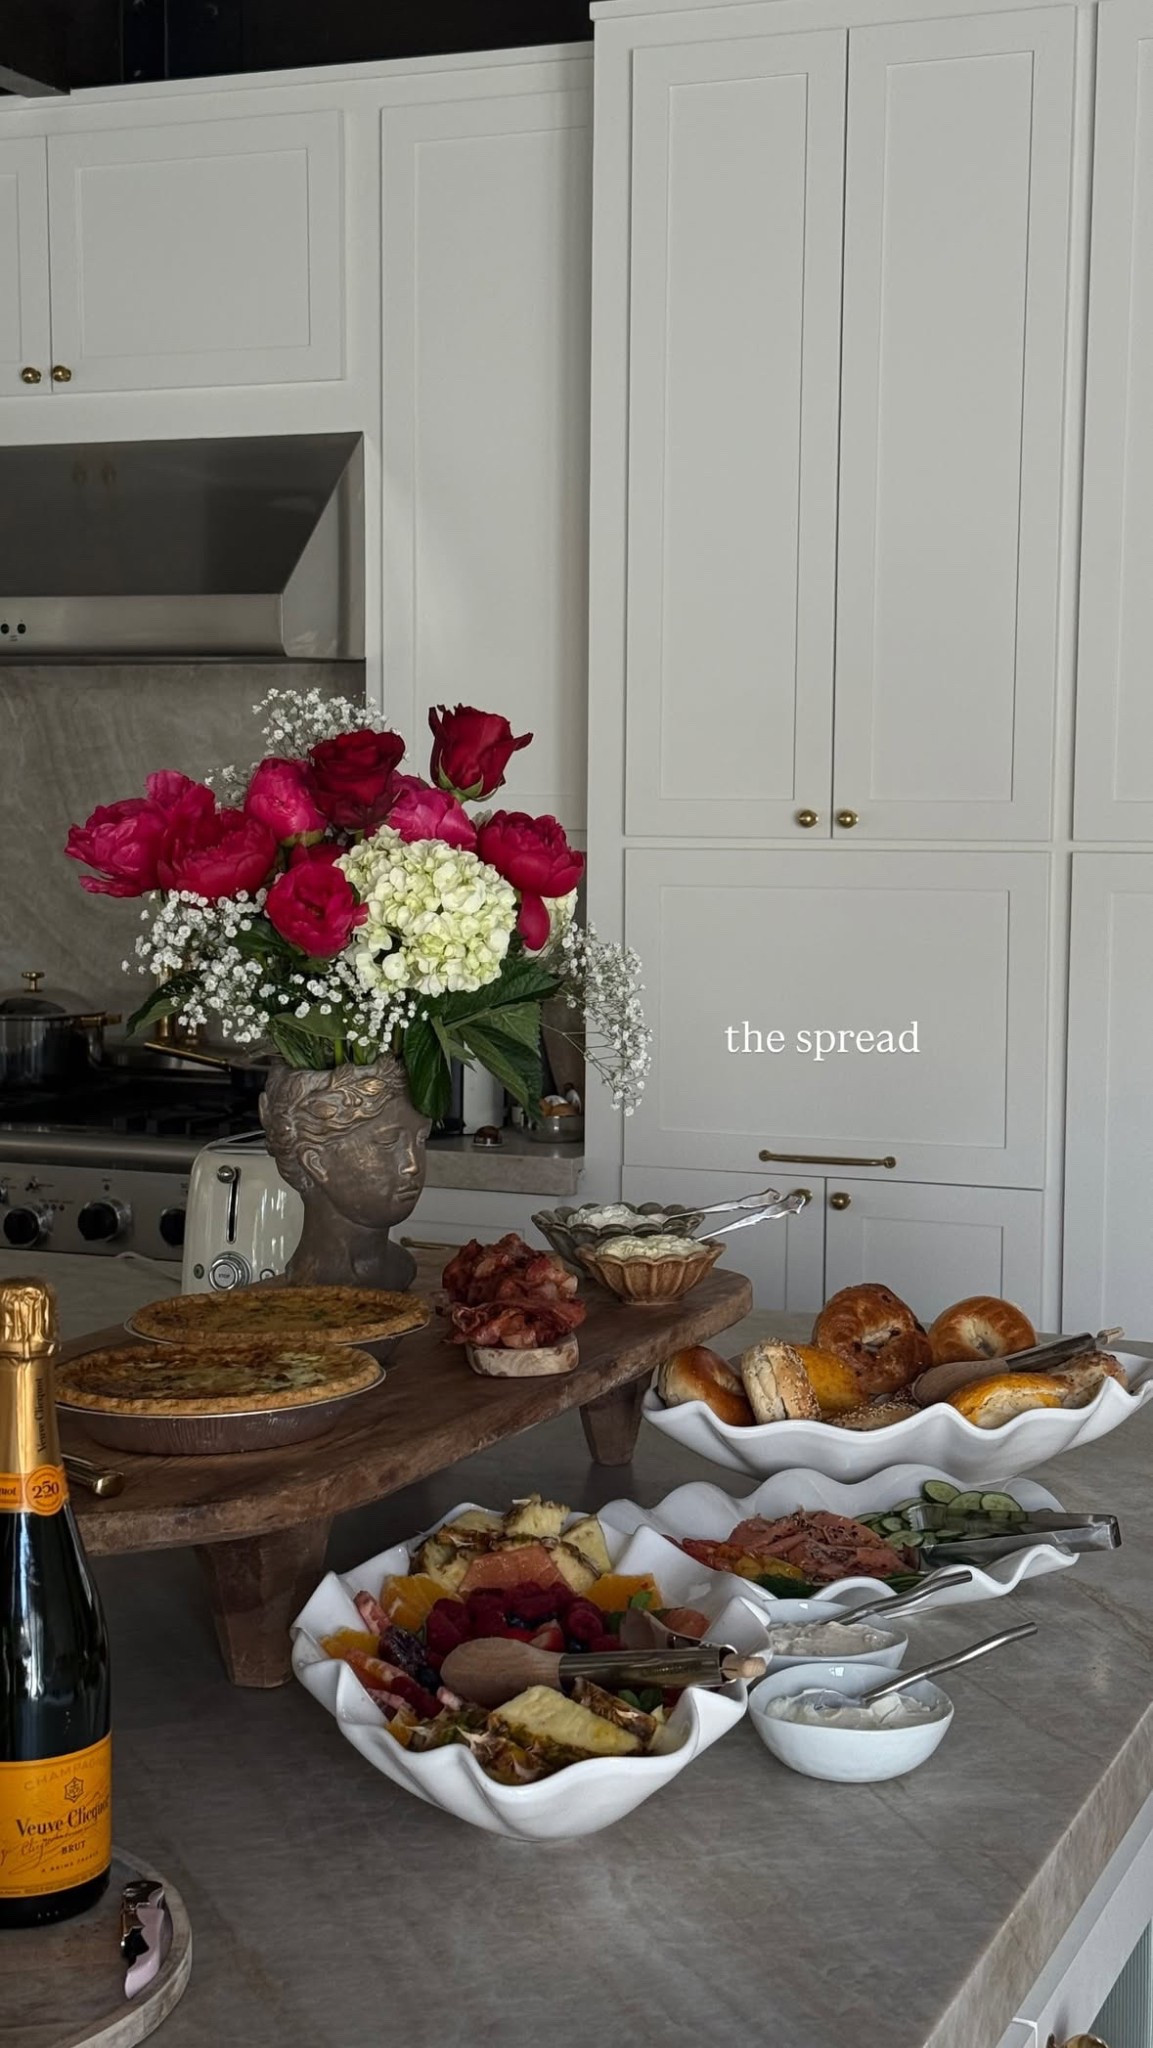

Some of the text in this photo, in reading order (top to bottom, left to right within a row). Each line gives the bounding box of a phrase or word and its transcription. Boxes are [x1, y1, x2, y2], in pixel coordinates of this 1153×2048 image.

[34, 1377, 47, 1453] Veuve Clicquot
[32, 1480, 60, 1499] 250
[24, 1757, 106, 1791] CHAMPAG
[16, 1818, 63, 1837] Veuve
[61, 1840, 86, 1855] BRUT
